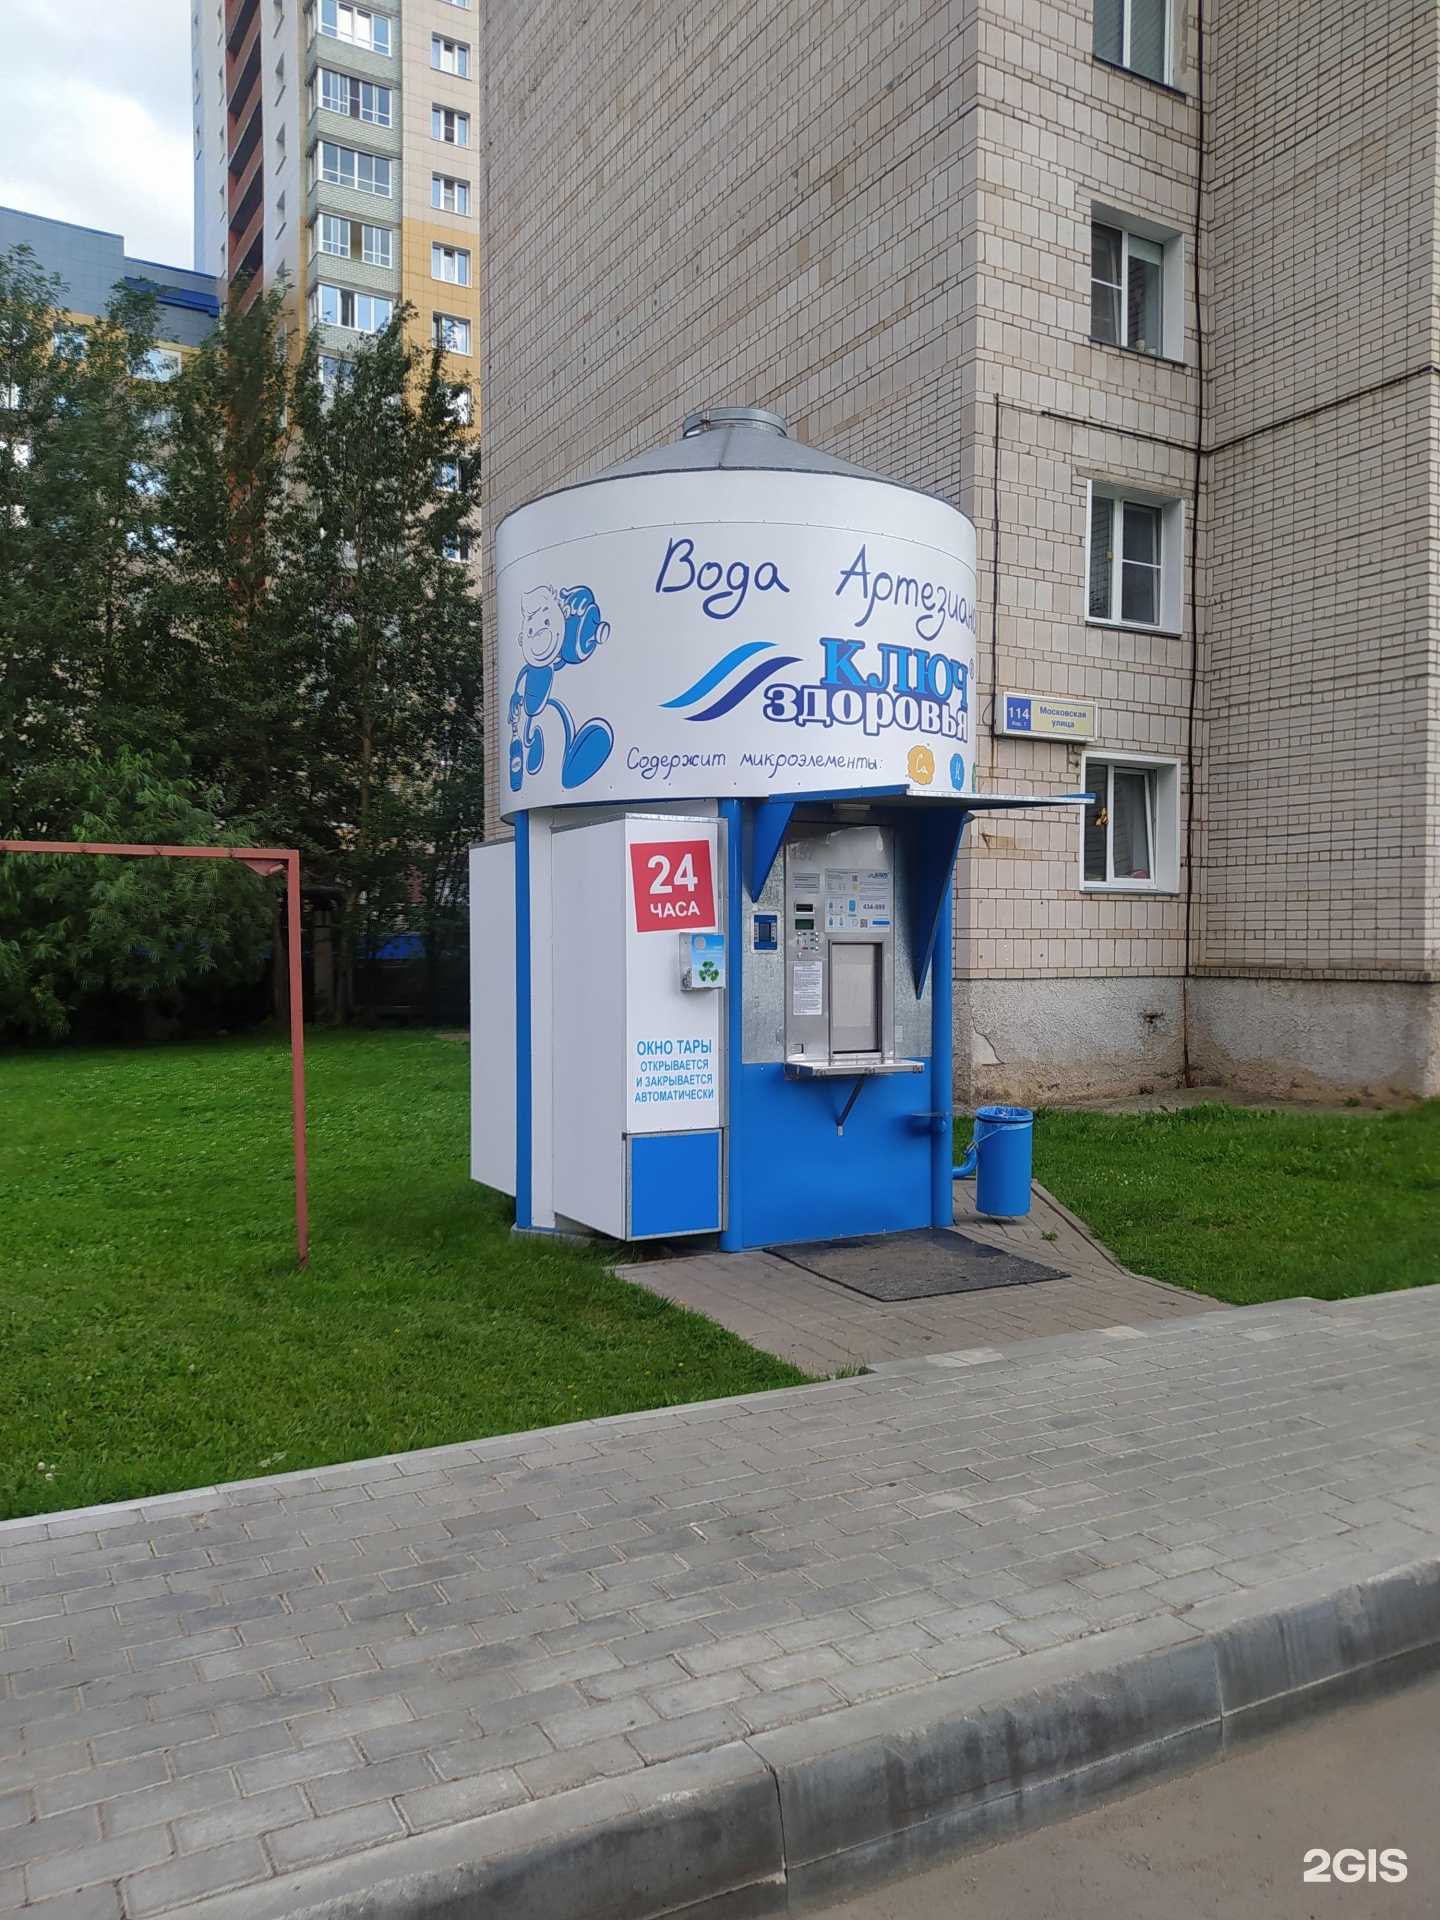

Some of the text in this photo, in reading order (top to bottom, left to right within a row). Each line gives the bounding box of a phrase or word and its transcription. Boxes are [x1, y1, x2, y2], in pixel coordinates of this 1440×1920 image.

[655, 537, 790, 620] Вода
[1008, 706, 1030, 720] 114
[1040, 706, 1087, 718] Московская
[1052, 719, 1075, 728] улица
[626, 747, 883, 780] Содержит микроэлементы:
[648, 853, 698, 895] 24
[650, 901, 701, 919] ЧАСА
[637, 1039, 712, 1056] ОКНО ТАРЫ
[641, 1059, 709, 1072] ОТКРЫВАЕТСЯ
[636, 1073, 713, 1087] И ЗАКРЫВАЕТСЯ
[634, 1088, 714, 1103] АВТОМАТИЧЕСКИ
